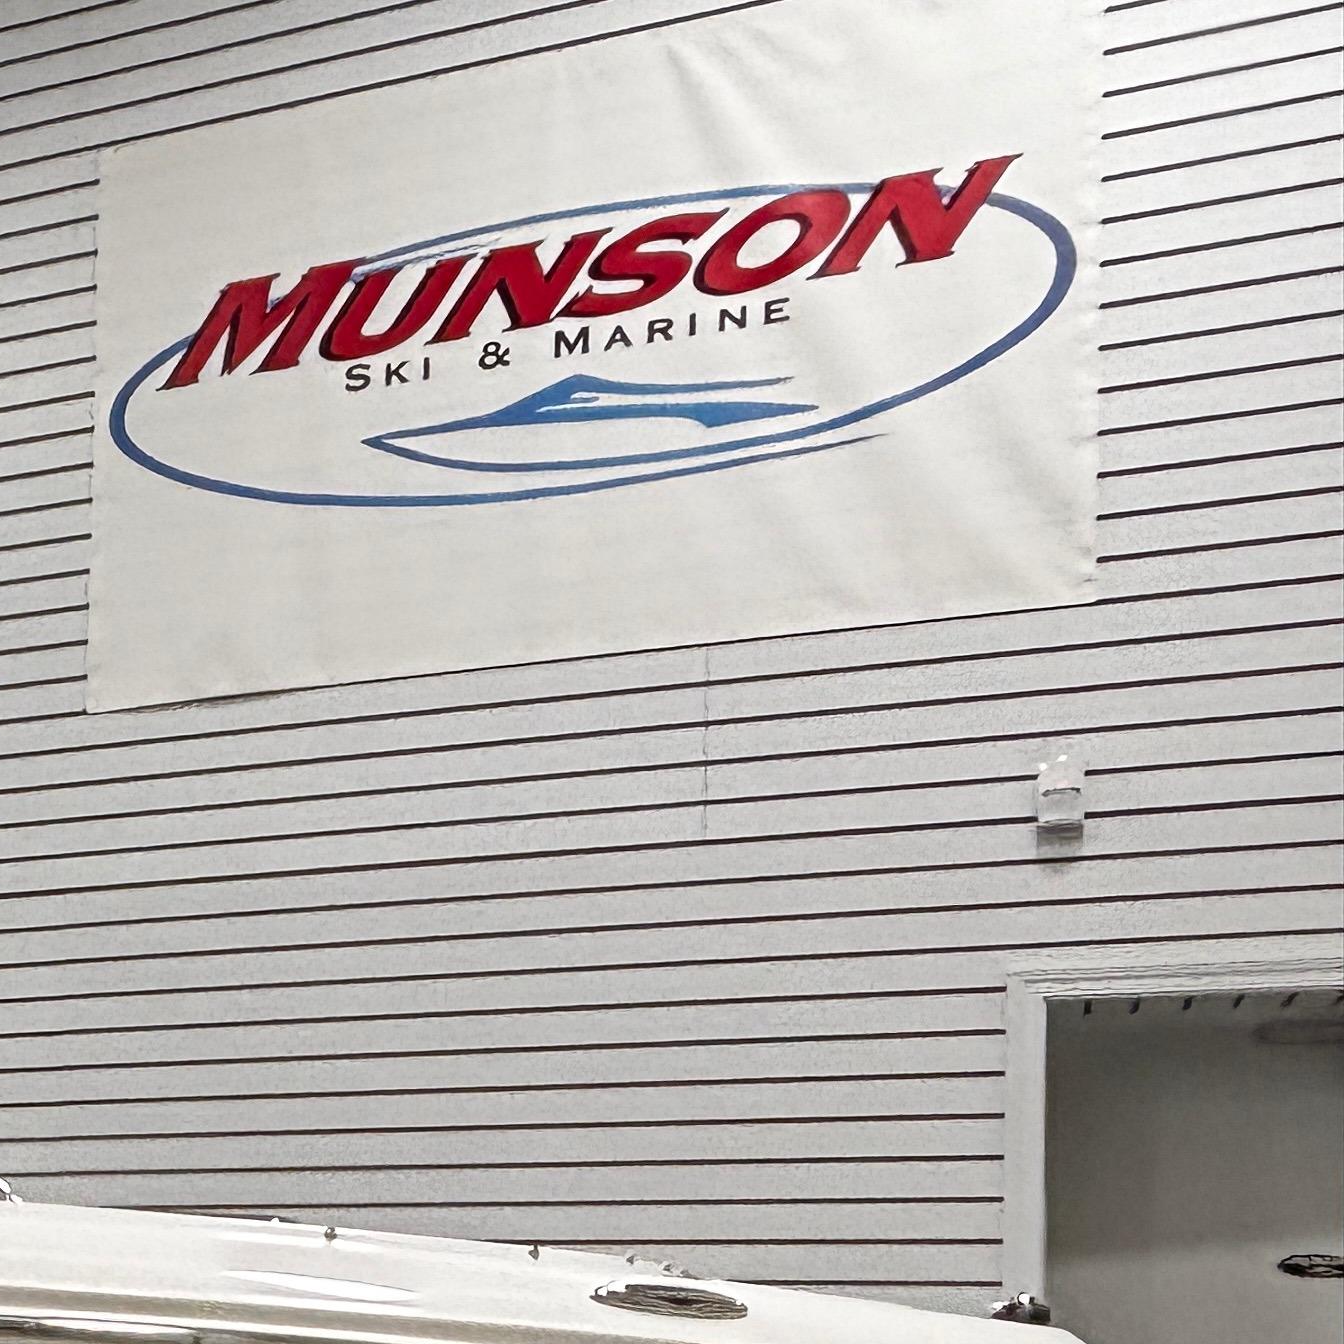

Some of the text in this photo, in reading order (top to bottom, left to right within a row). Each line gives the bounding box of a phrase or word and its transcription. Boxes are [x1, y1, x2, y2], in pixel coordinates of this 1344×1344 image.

[156, 153, 1023, 391] MUNSON
[345, 297, 792, 393] SKI & MARINE
